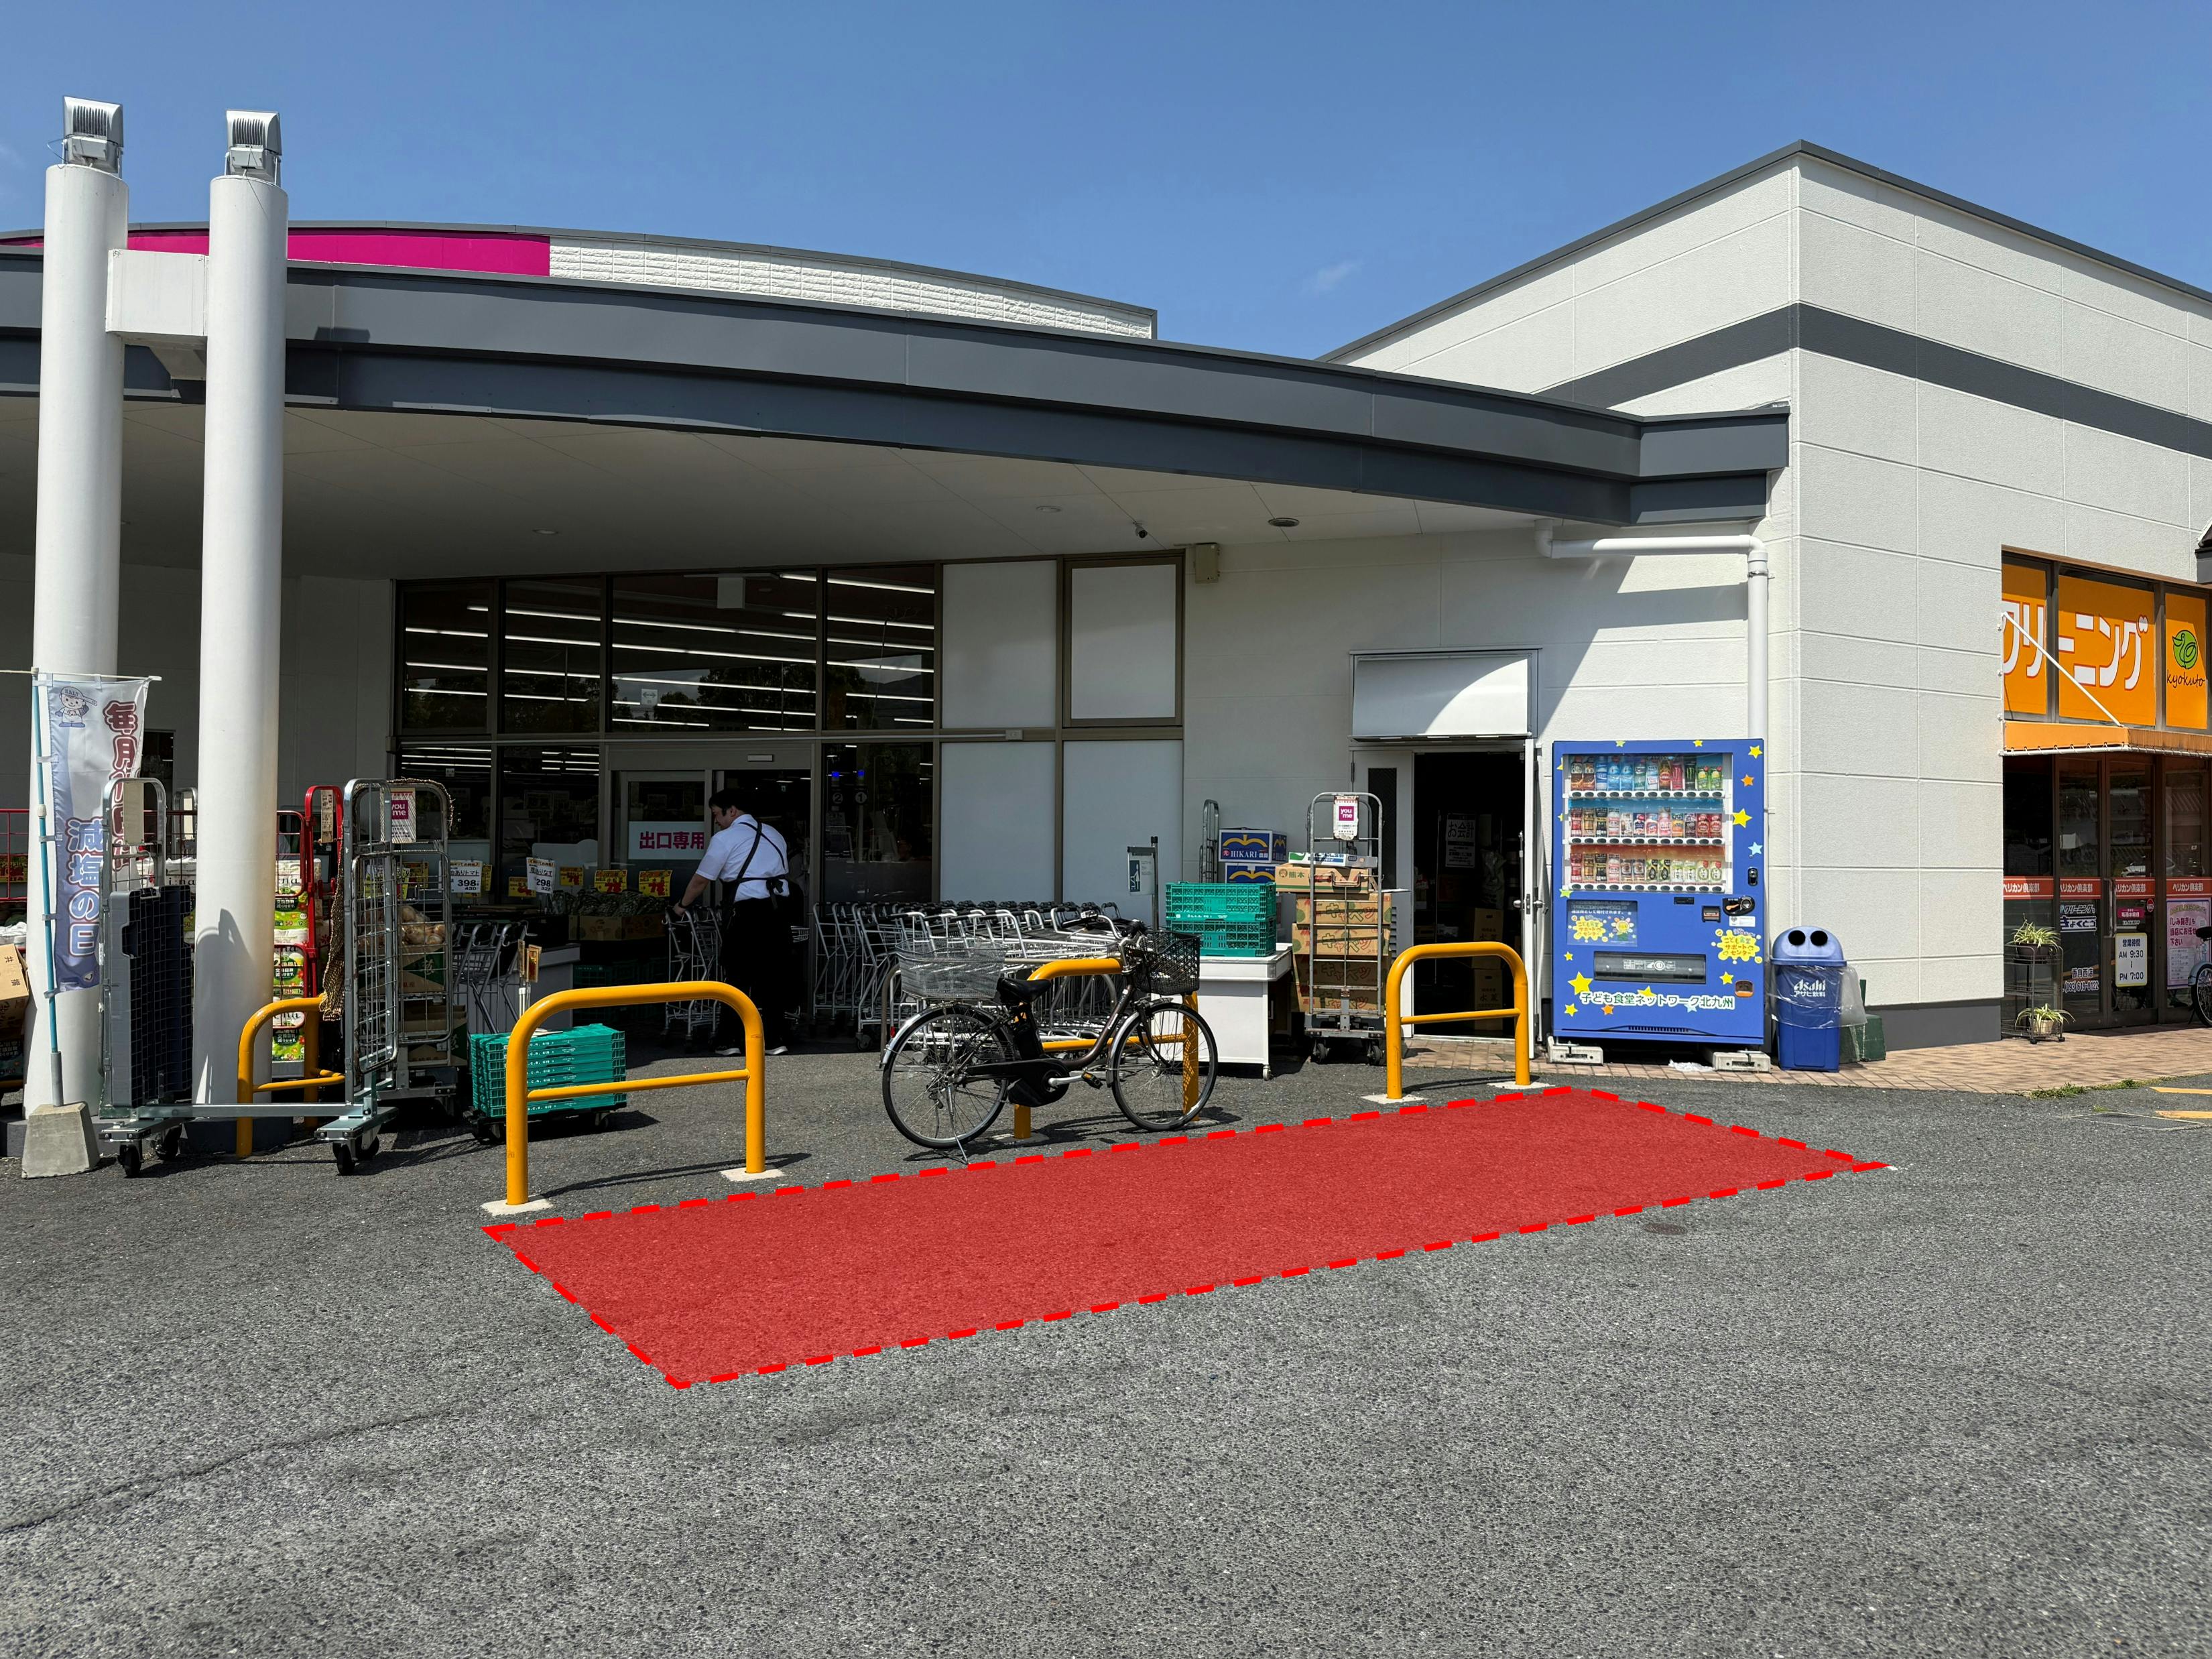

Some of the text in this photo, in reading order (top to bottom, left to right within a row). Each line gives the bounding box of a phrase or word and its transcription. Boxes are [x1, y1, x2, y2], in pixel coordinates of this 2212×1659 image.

[2002, 599, 2148, 690] クリーニング
[2166, 670, 2205, 688] kyokuto
[1448, 820, 1475, 838] お会計
[639, 831, 705, 850] 出口専用
[536, 878, 552, 887] 298
[2122, 938, 2141, 947] 営業時間
[2170, 938, 2183, 946] 下さい
[2130, 950, 2144, 959] 9:30
[2130, 971, 2144, 980] 7:00
[1794, 979, 1826, 991] Asahi
[1581, 992, 1735, 1008] 子ども食堂ネットワーク北九州
